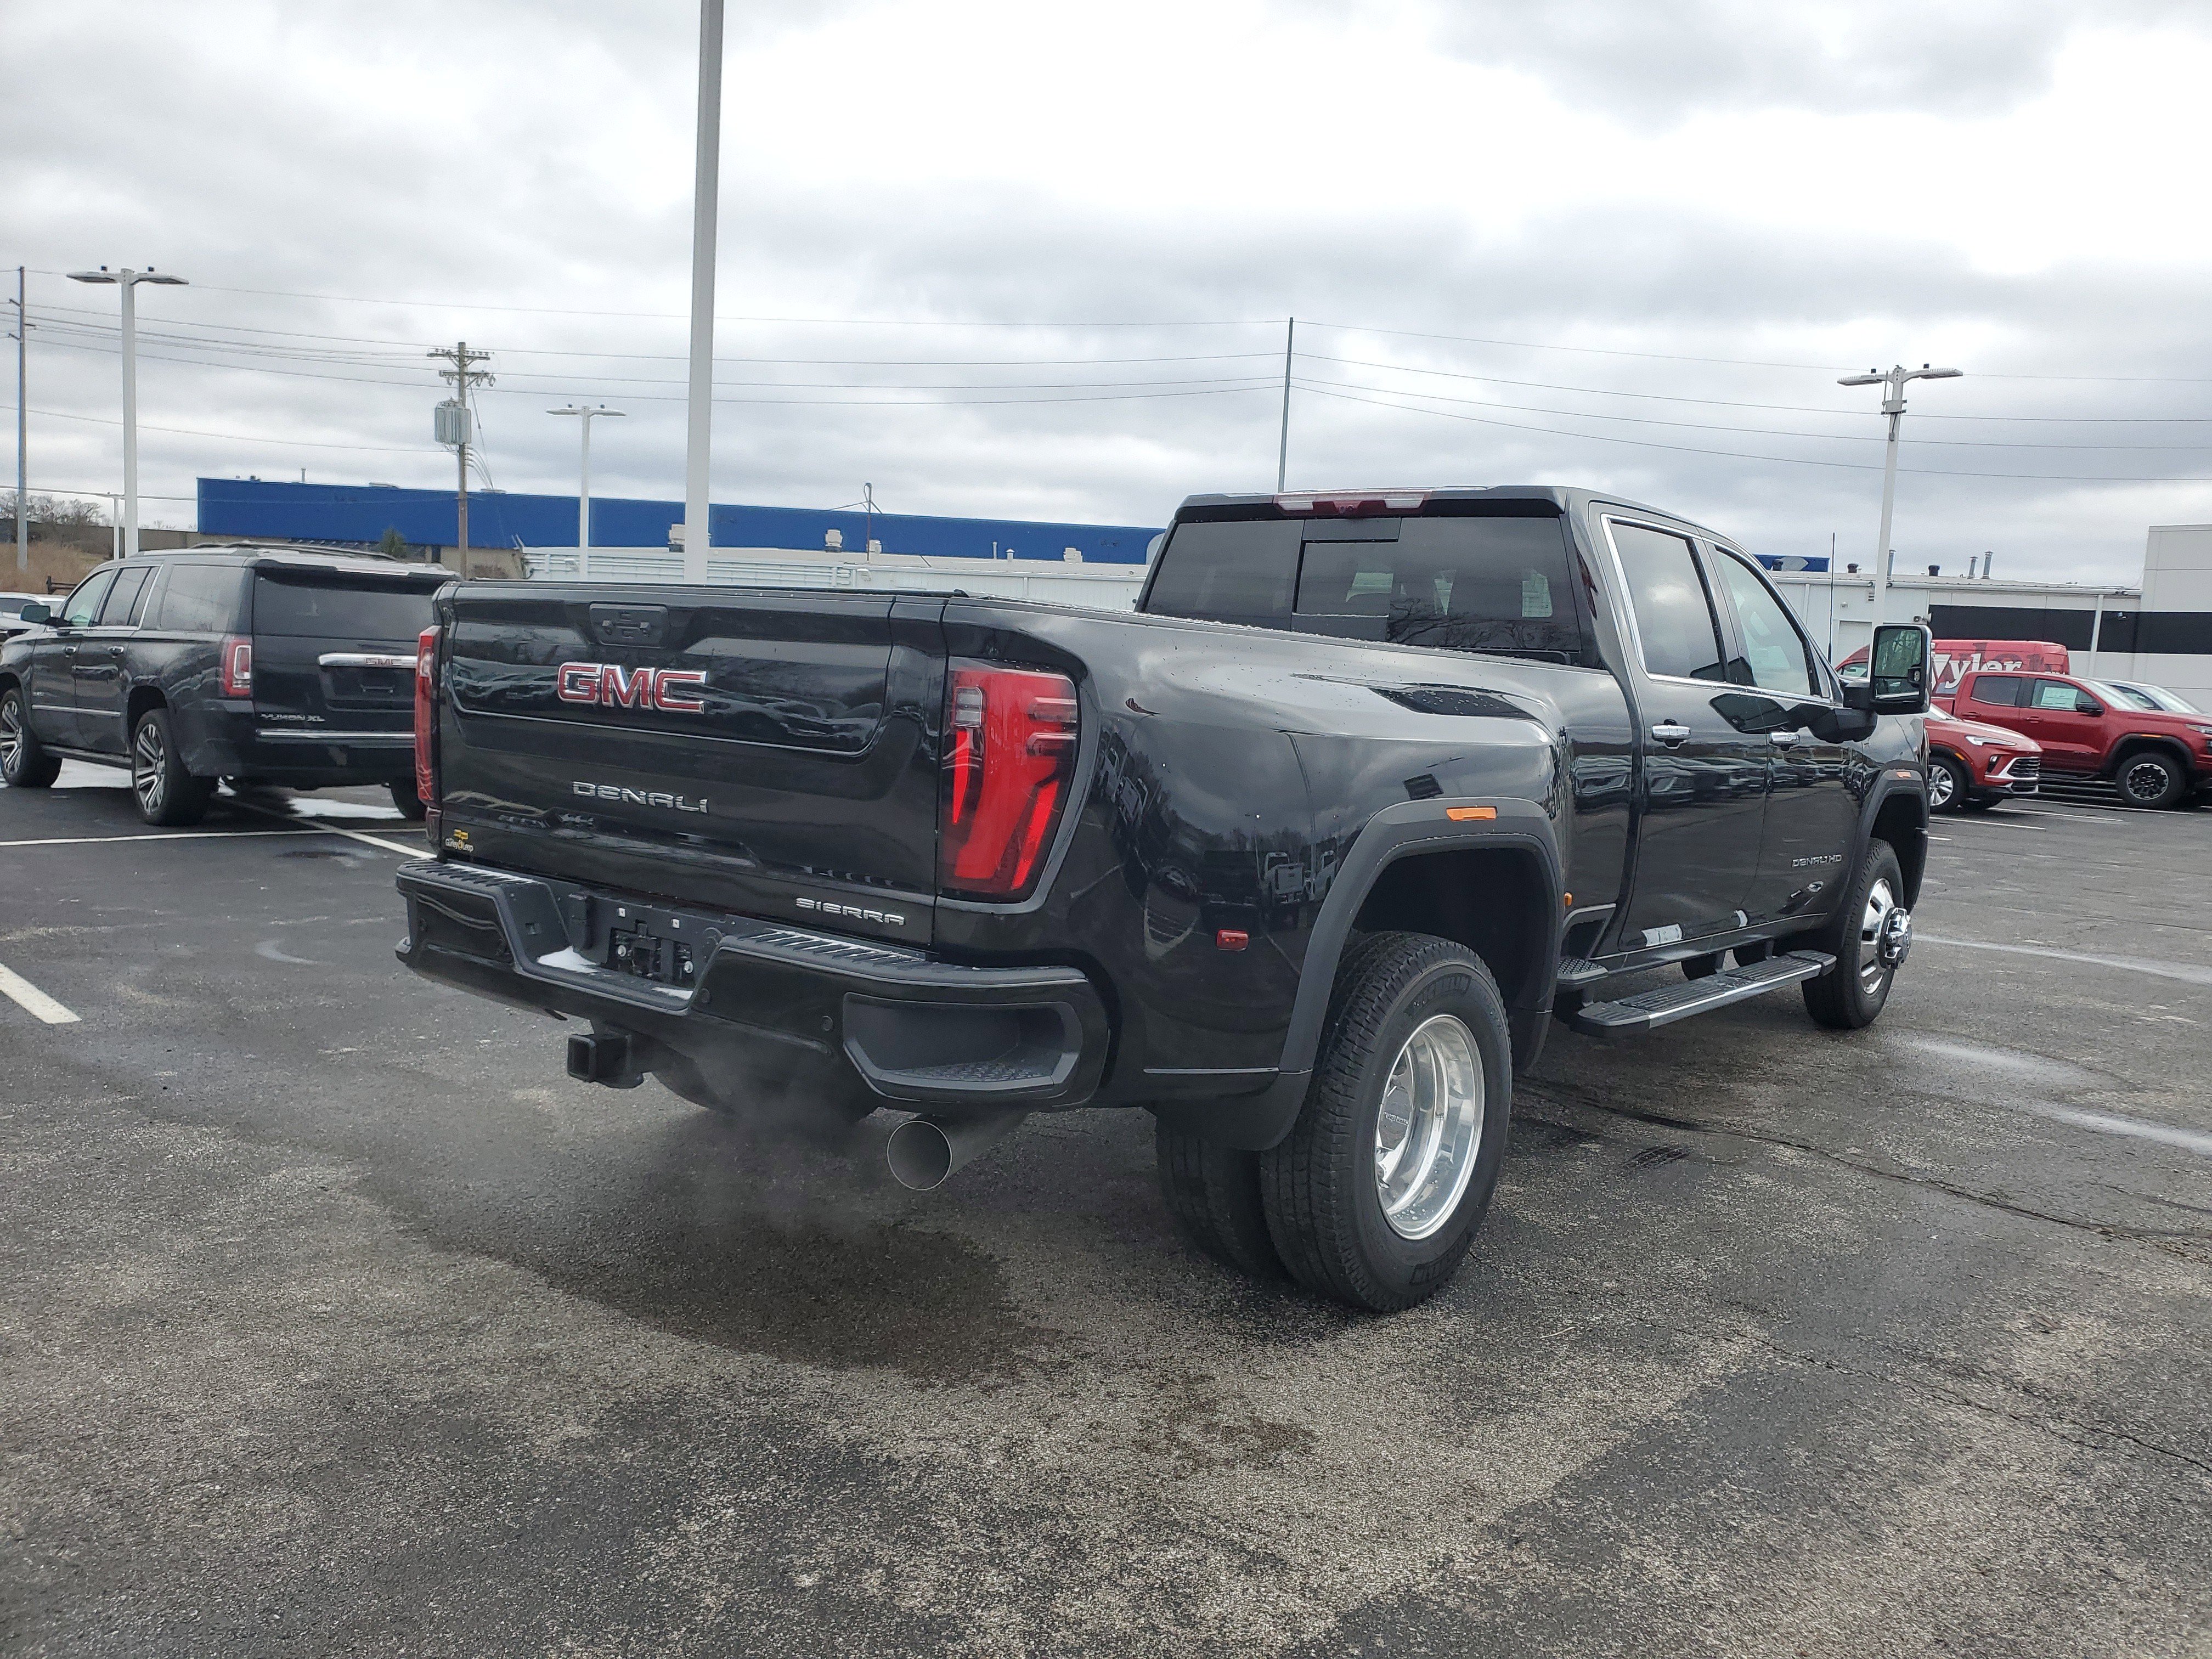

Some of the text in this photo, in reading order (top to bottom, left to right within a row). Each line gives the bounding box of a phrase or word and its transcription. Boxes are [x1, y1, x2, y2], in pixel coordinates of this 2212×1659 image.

[364, 658, 402, 666] GMC
[557, 662, 707, 714] GMC
[572, 781, 708, 814] DENALI
[1791, 854, 1842, 867] DENALI HD
[795, 898, 905, 926] SIERRA
